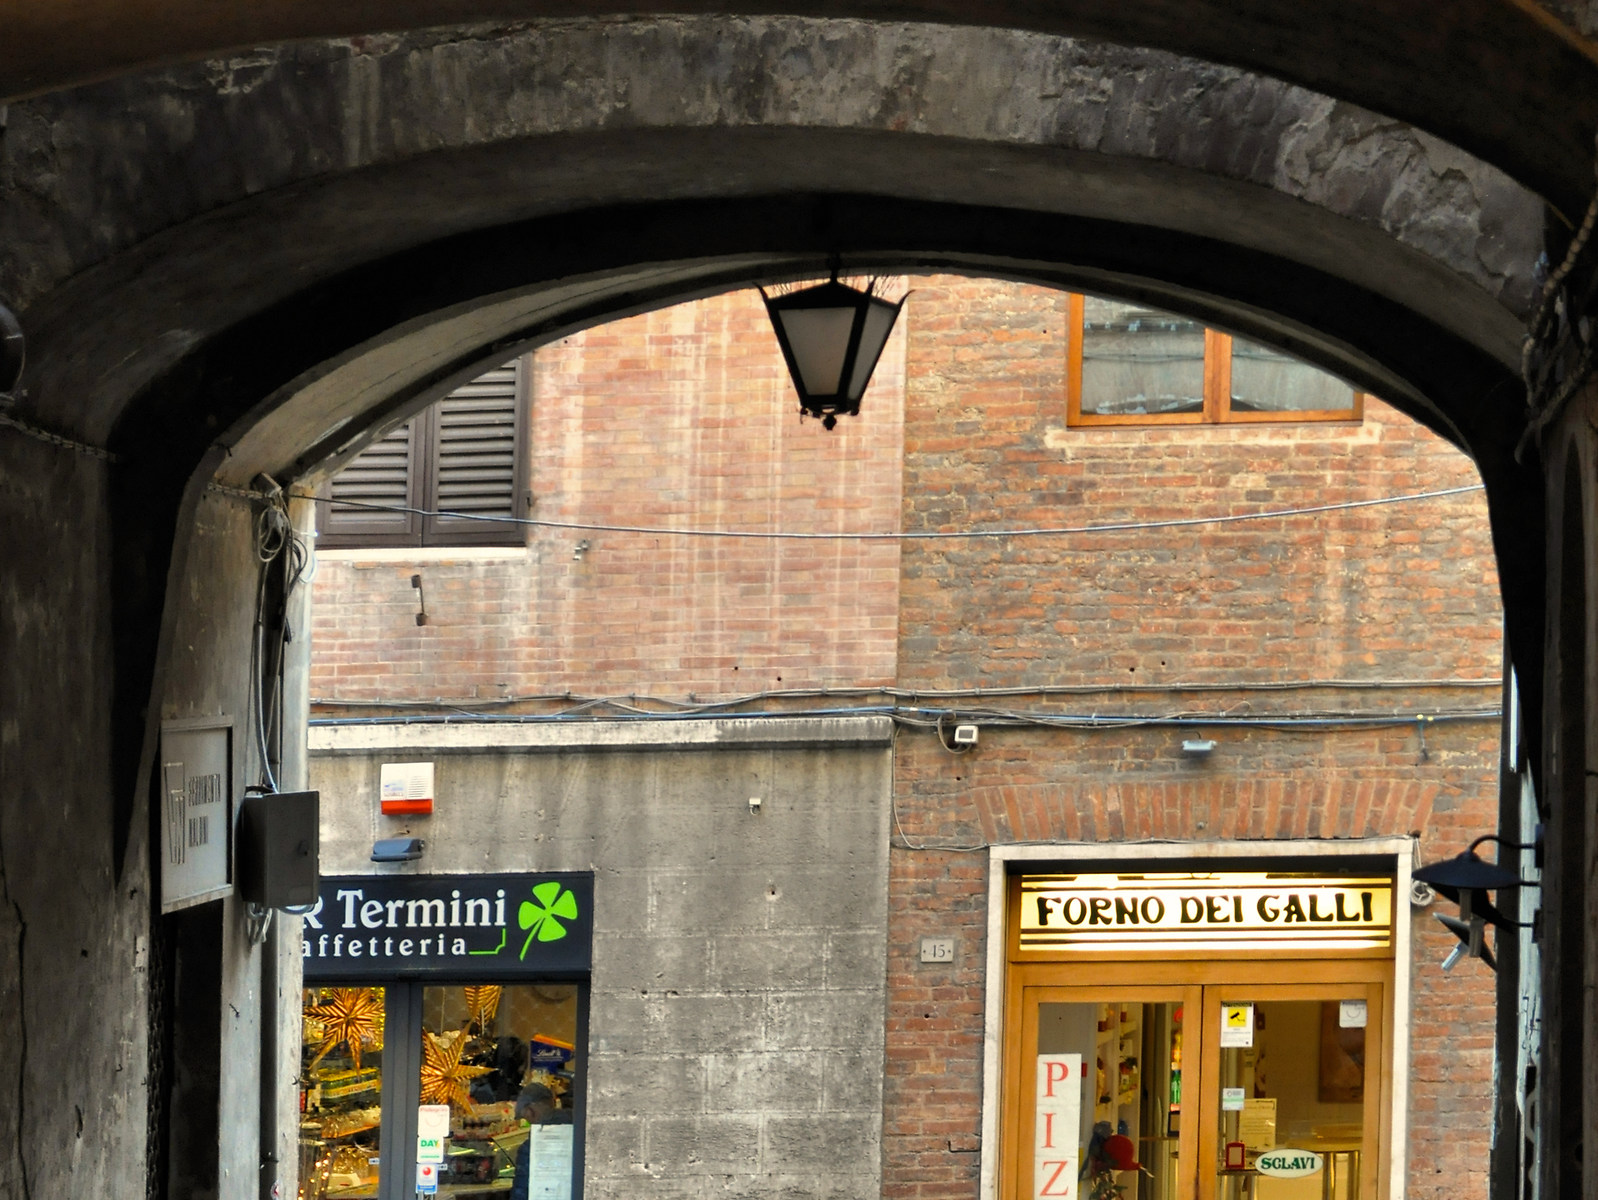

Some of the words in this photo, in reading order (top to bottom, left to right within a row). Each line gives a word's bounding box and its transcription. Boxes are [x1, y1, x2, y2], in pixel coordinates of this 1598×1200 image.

[336, 889, 506, 928] Termini
[1037, 896, 1165, 925] FORNO
[1180, 895, 1244, 924] DEI
[1257, 892, 1374, 922] GALLI
[302, 934, 466, 957] affetteria
[933, 944, 945, 957] 15
[1261, 1157, 1315, 1170] SCLAVI
